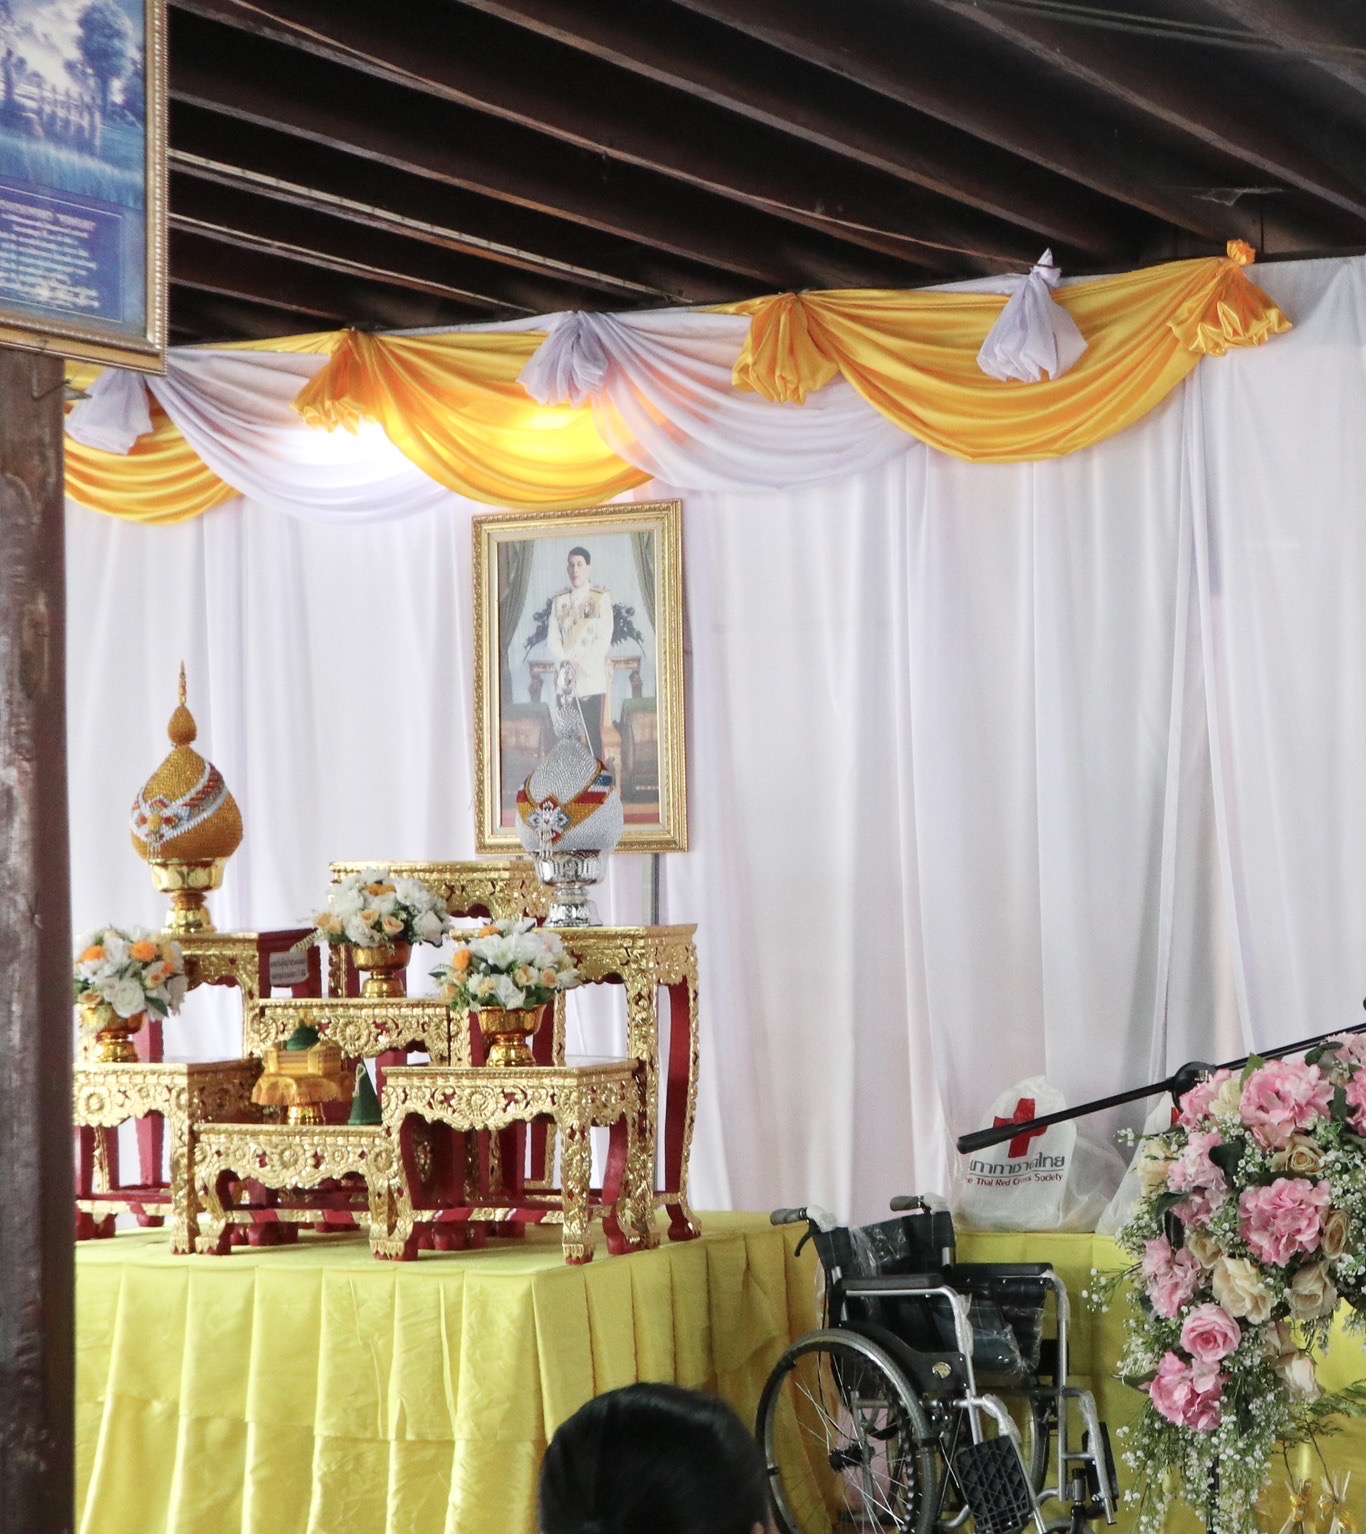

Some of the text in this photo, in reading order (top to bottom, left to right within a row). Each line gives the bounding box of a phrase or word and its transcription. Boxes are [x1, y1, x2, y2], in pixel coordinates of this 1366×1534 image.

[970, 1152, 1065, 1175] ภากาชาดไทย
[976, 1177, 993, 1187] Thai
[996, 1178, 1010, 1186] Red
[1034, 1173, 1063, 1182] Society
